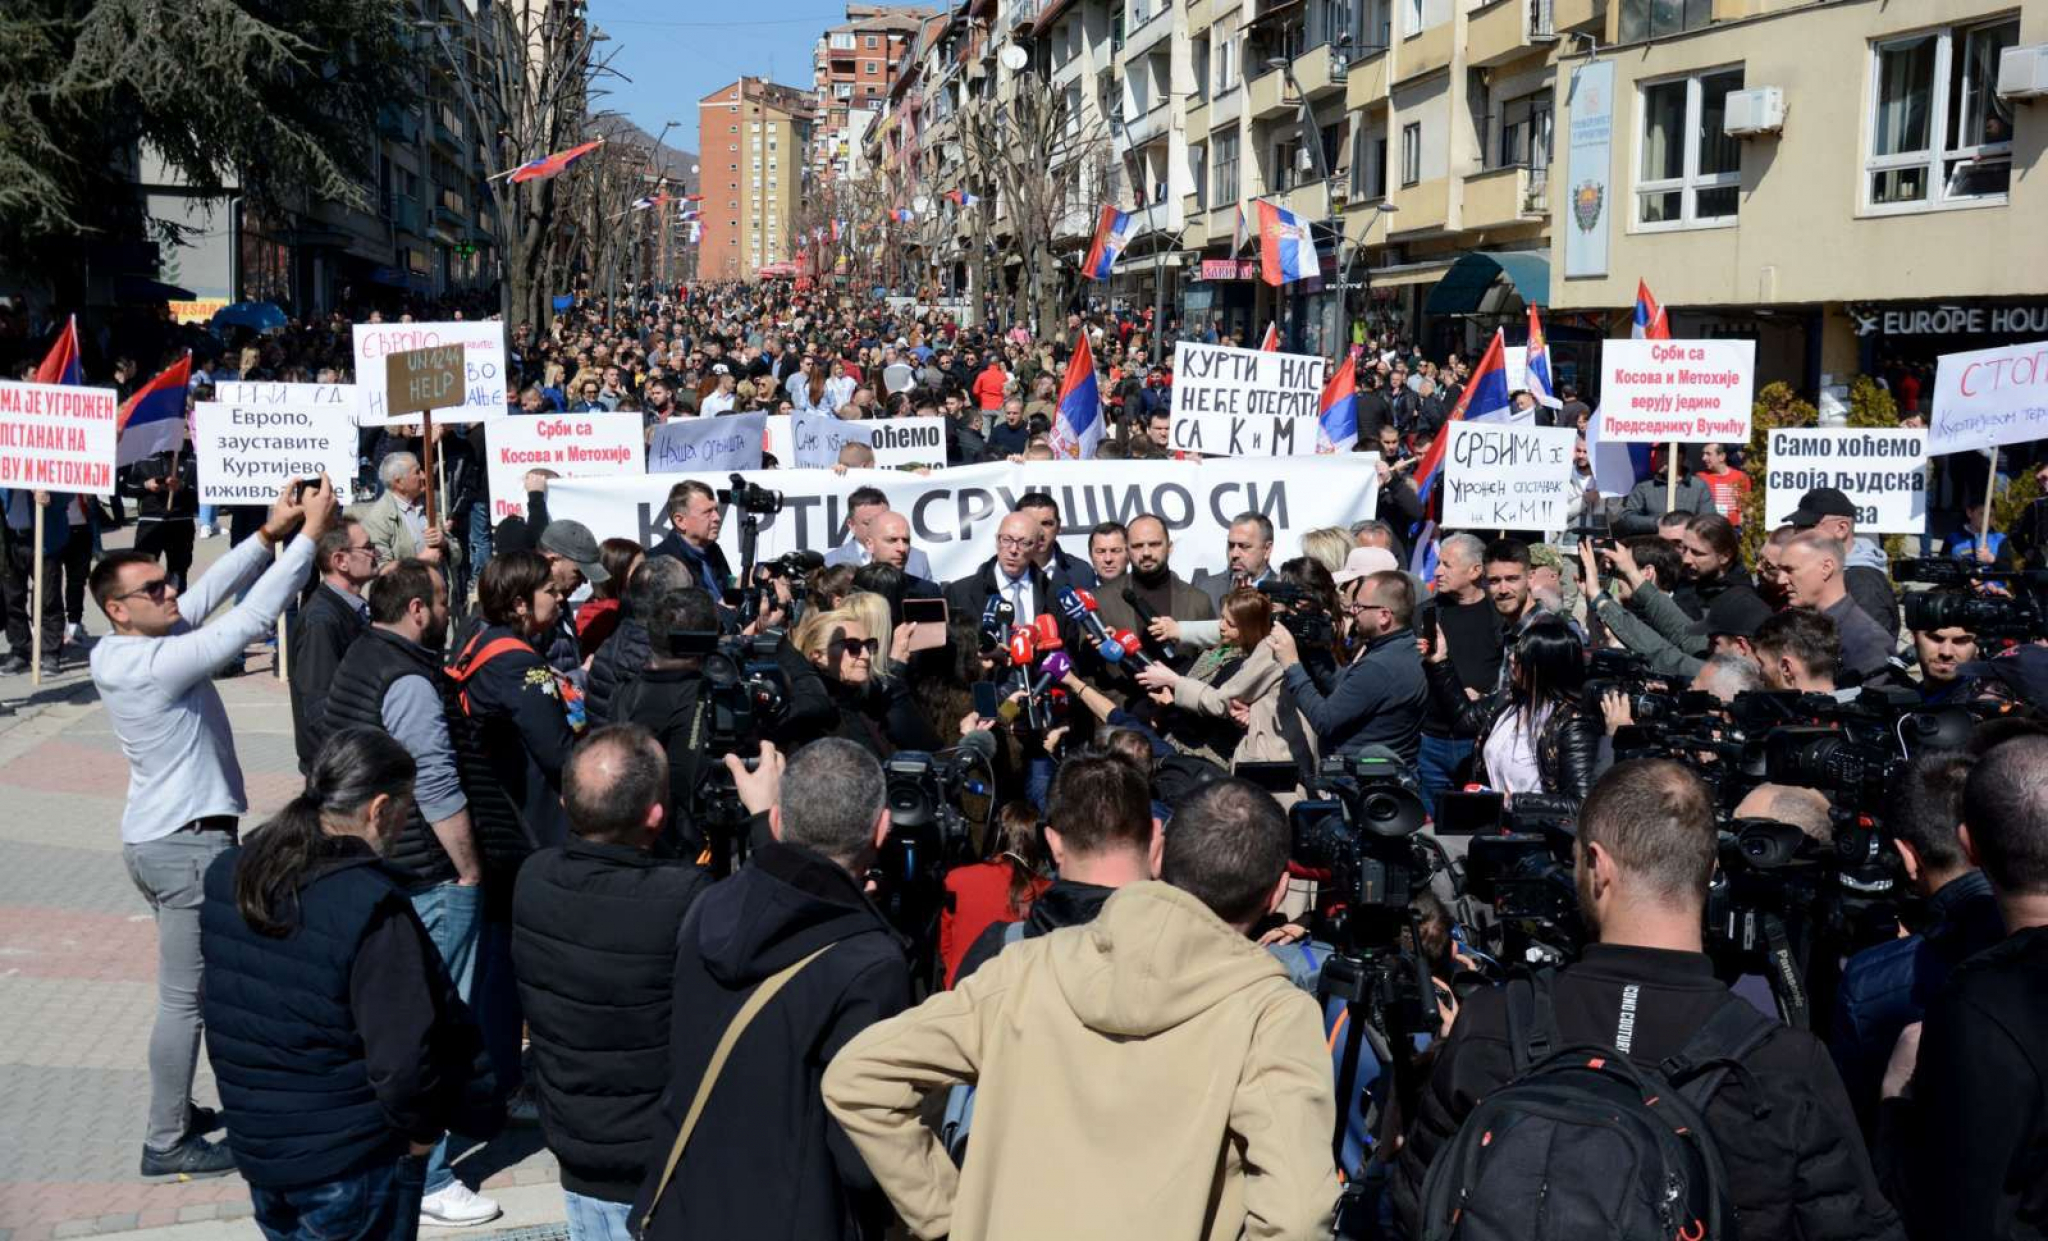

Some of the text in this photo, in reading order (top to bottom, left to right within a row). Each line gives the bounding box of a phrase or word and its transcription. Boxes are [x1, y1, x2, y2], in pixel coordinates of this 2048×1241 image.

[1884, 308, 1986, 334] EUROPE
[1651, 344, 1705, 363] Срби са
[1183, 348, 1322, 390] КУРТИ НАС
[1615, 369, 1739, 388] Косова и Метохије
[410, 372, 453, 400] HELP
[26, 389, 42, 415] ЈЕ
[44, 391, 114, 420] УГРОЖЕН
[1247, 389, 1321, 417] ОТЕРАТИ
[1631, 394, 1721, 411] верују једино
[232, 409, 313, 428] Европо,
[537, 420, 592, 440] Срби са
[1606, 417, 1746, 436] Председнику Вучићу
[68, 428, 86, 451] НА
[218, 436, 329, 453] зауставите
[871, 425, 939, 449] оћемо
[1175, 418, 1203, 448] СА
[1774, 433, 1921, 457] Само хоћемо
[501, 444, 631, 465] Косова и Метохије
[1454, 430, 1542, 468] СРБИМА
[25, 458, 33, 482] И
[37, 460, 110, 487] МЕТОХИЈИ
[223, 457, 326, 478] Куртијево
[1770, 467, 1924, 494] своја људска
